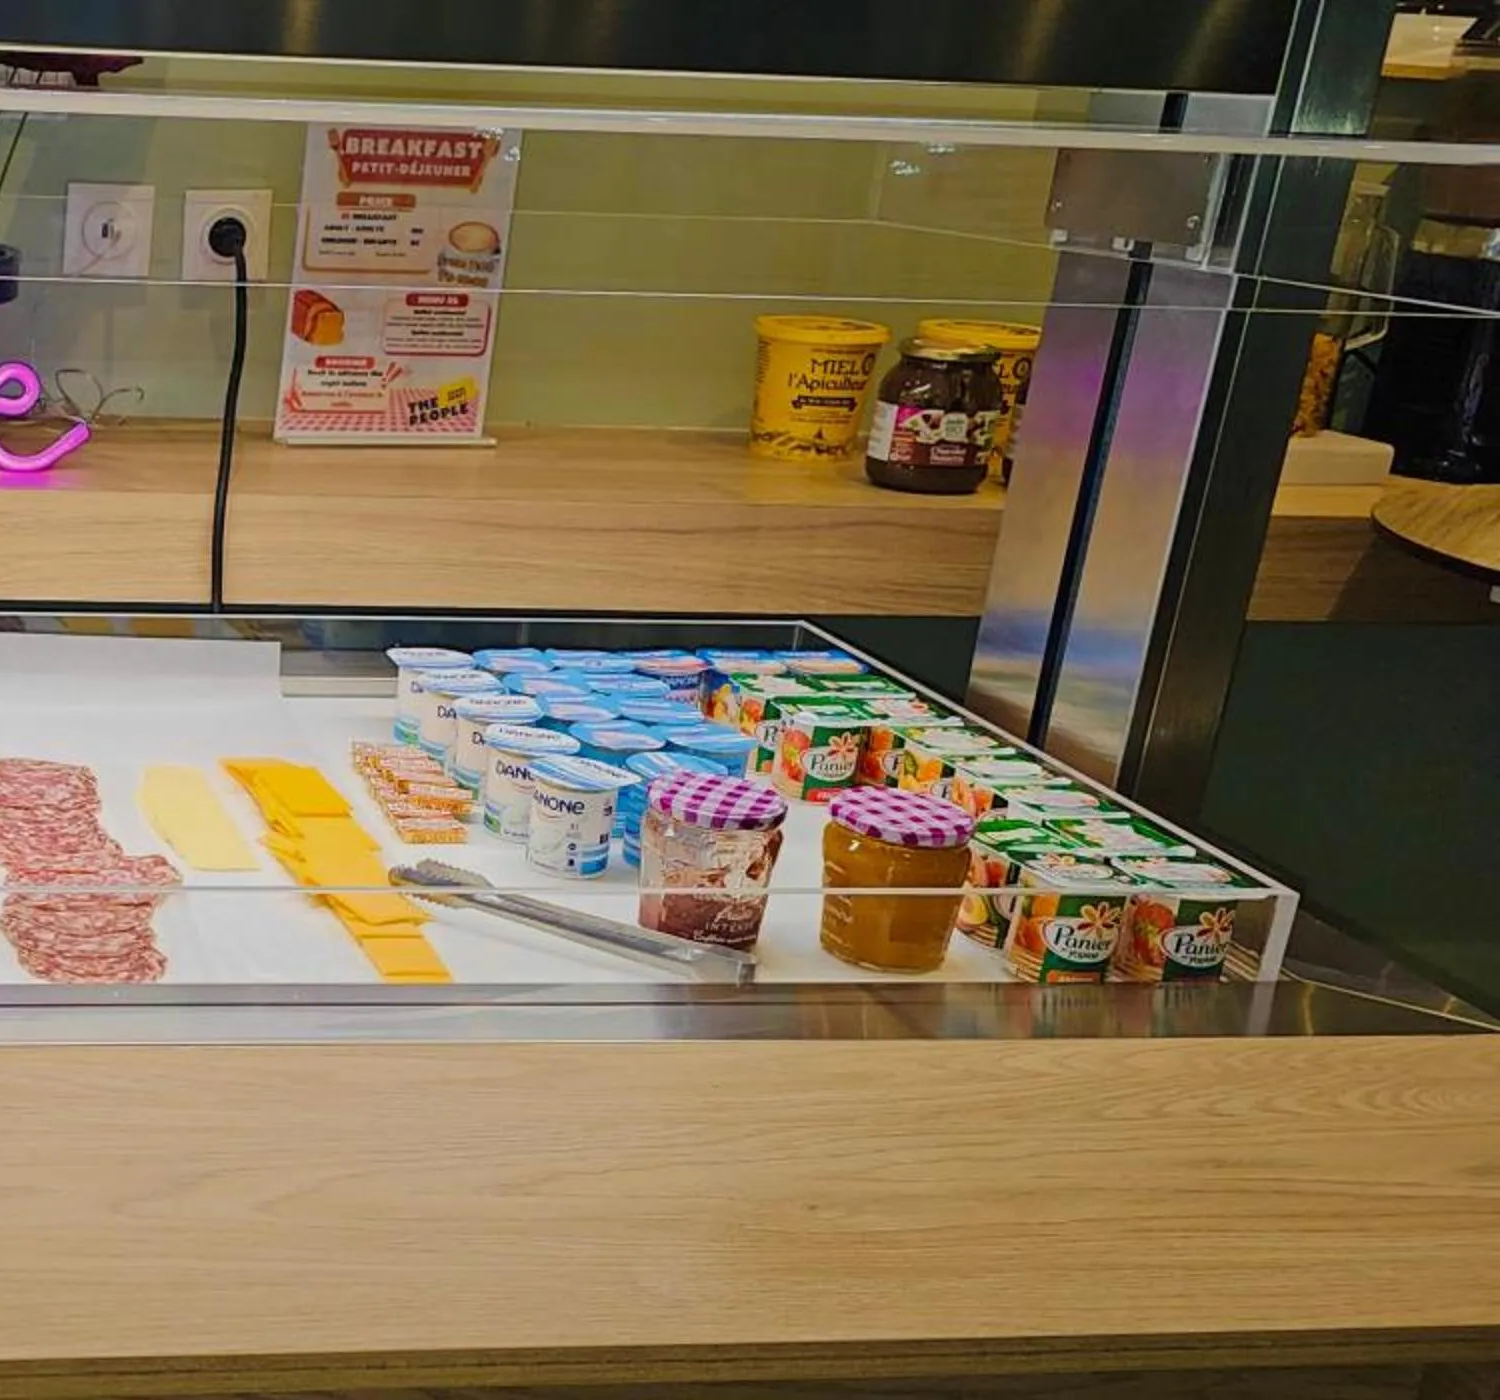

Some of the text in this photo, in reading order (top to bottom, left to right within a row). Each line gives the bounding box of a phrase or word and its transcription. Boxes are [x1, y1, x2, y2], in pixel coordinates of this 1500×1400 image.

[344, 137, 483, 159] BREAKFAST
[351, 160, 472, 177] PETIT-DÉJEUNER
[811, 358, 859, 375] MIEL
[407, 396, 439, 414] THE
[409, 401, 469, 426] PEOPLE
[1053, 923, 1112, 951] Panier
[1173, 932, 1227, 956] Panier
